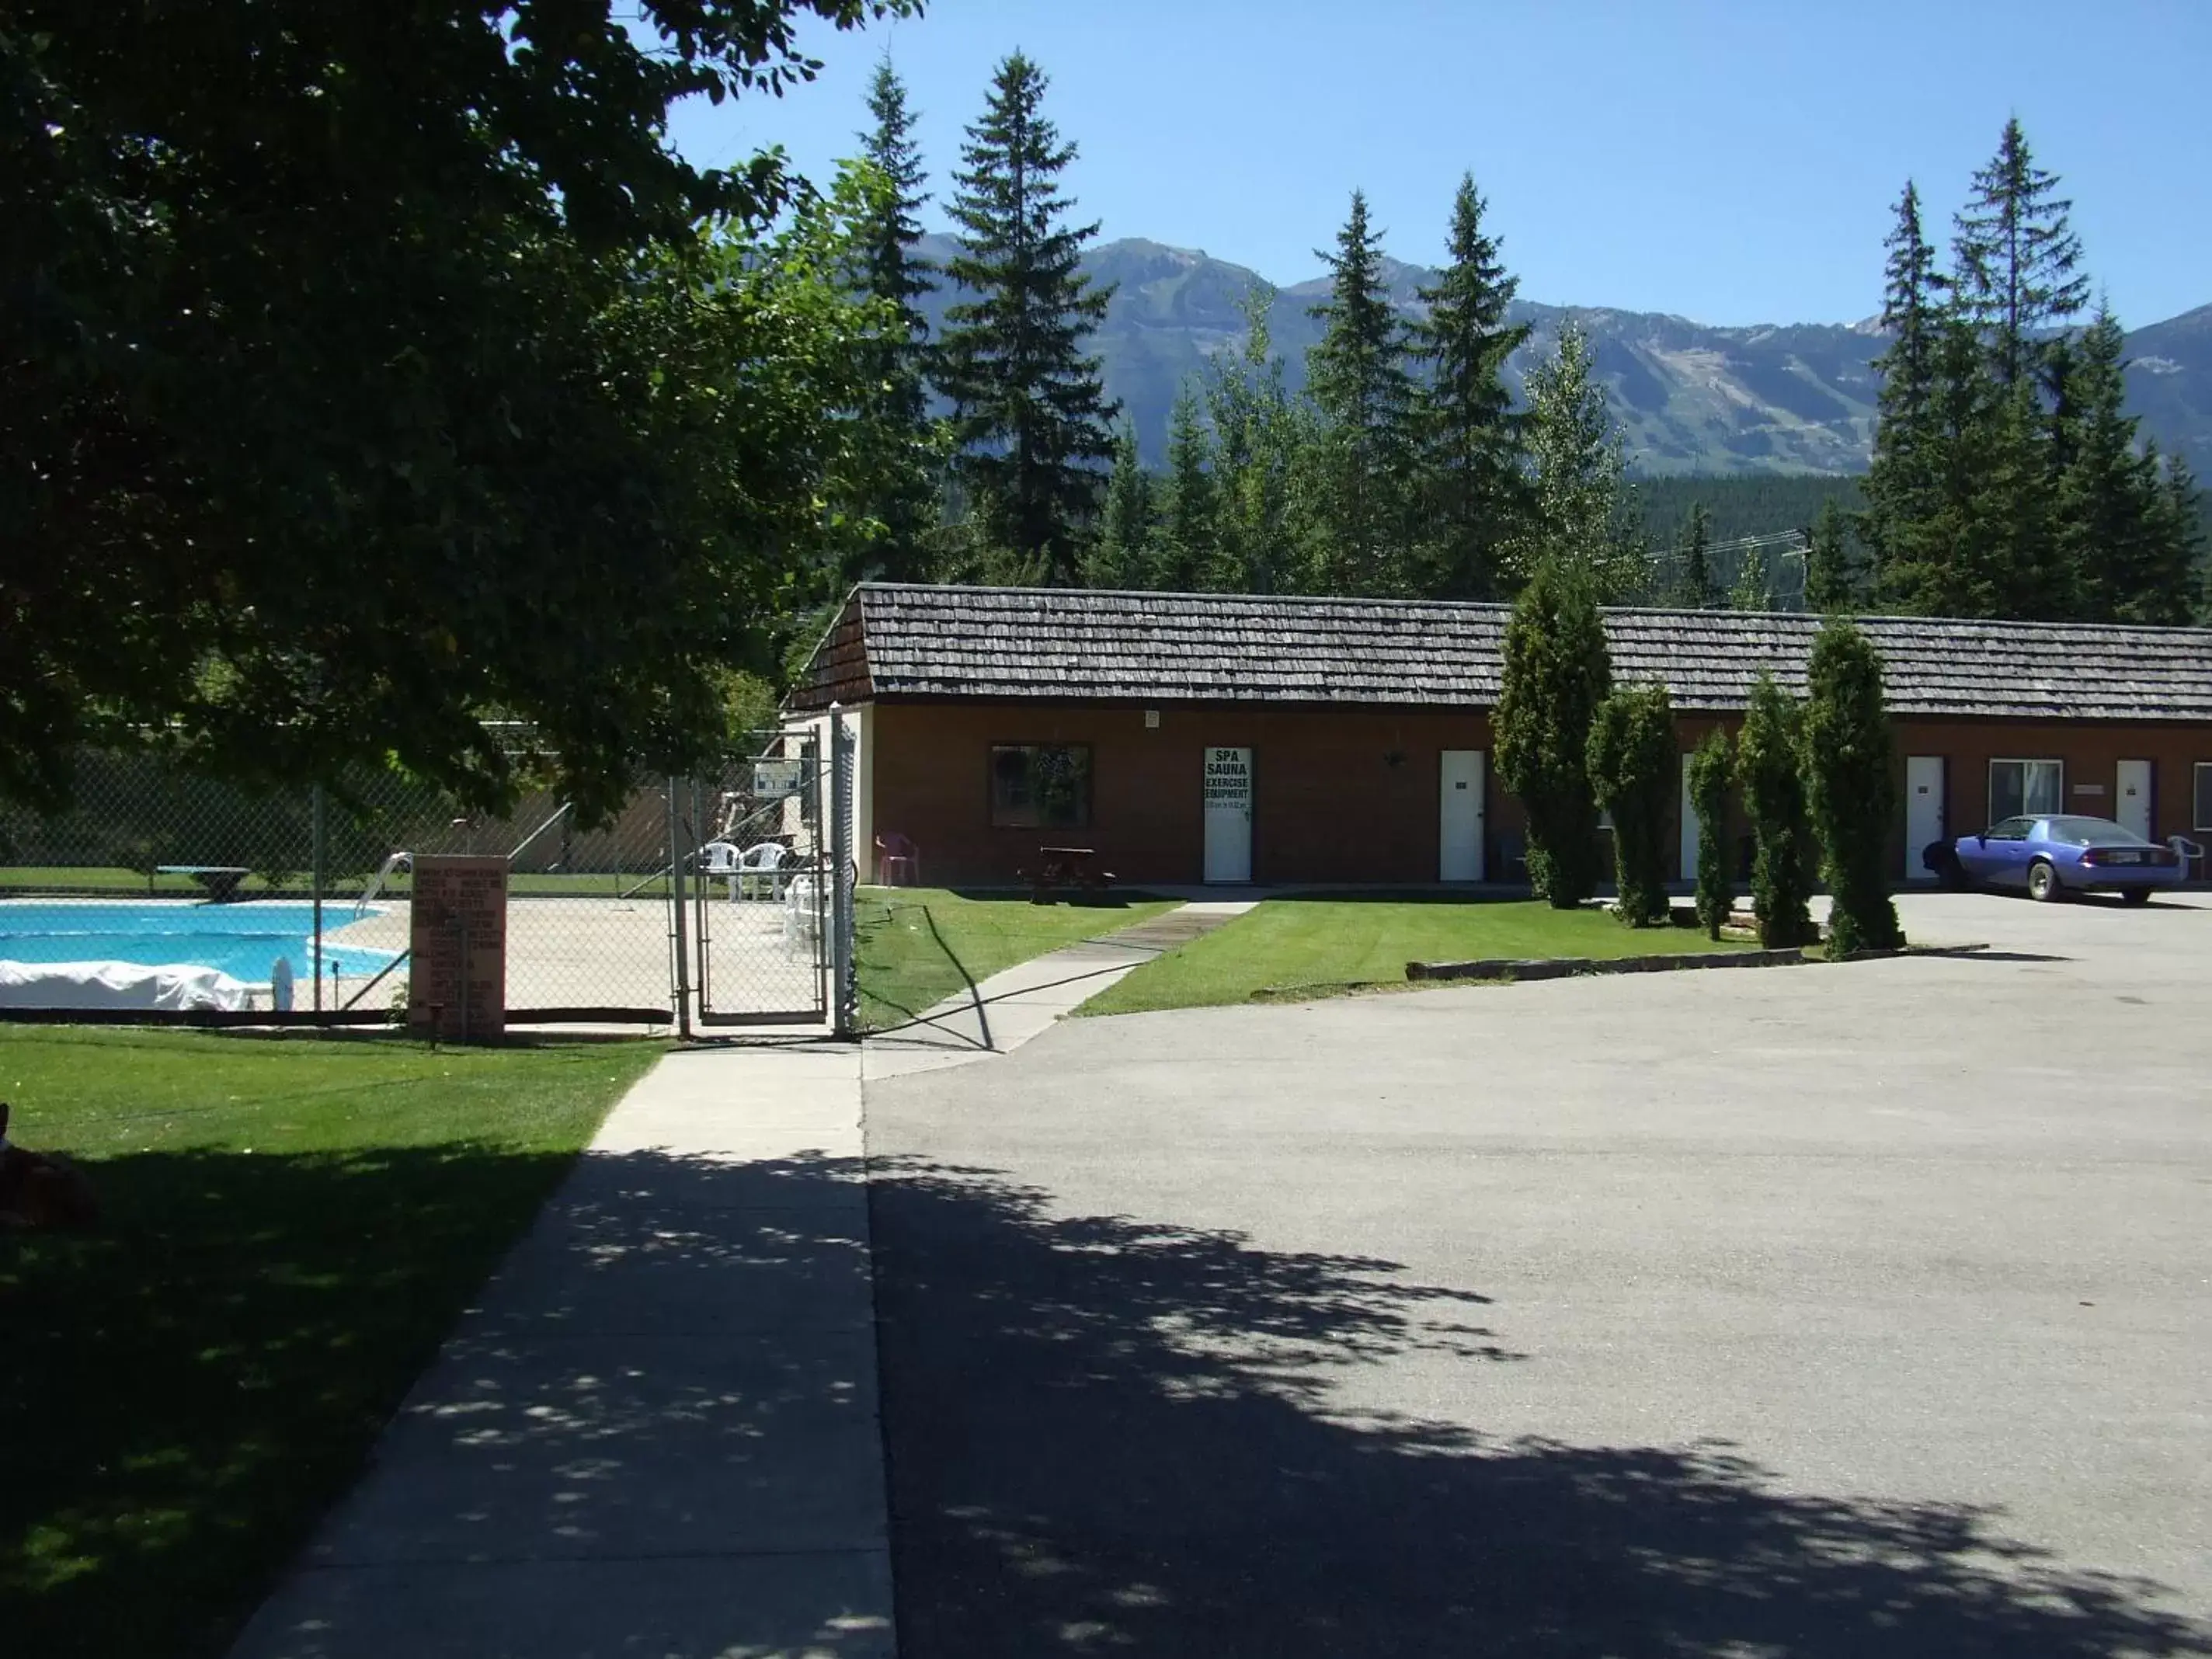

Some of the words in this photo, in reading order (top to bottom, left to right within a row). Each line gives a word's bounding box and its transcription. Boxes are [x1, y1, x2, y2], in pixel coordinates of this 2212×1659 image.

[1216, 750, 1239, 761] SPA
[1207, 763, 1247, 775] SAUNA
[1205, 777, 1248, 788] EXERCISE
